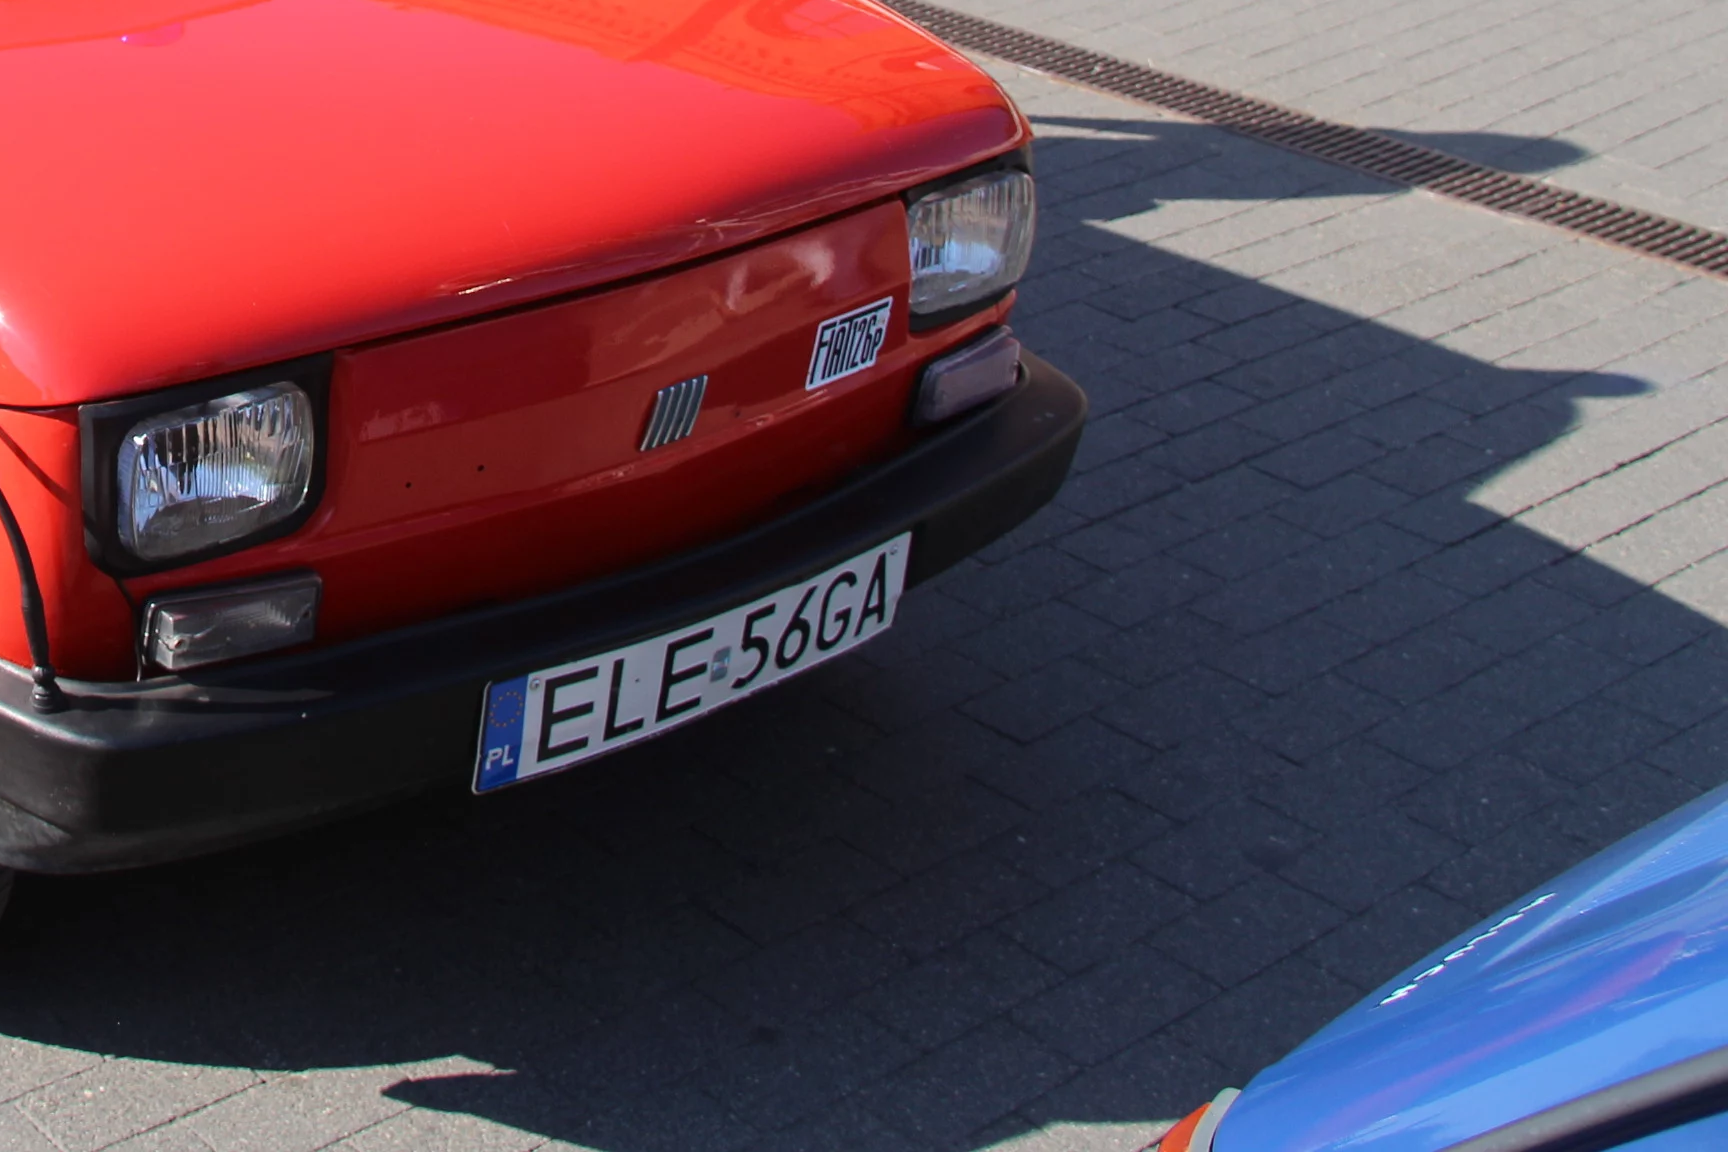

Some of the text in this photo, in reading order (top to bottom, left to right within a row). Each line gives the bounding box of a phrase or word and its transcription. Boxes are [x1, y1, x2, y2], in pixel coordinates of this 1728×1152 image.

[535, 550, 890, 763] ELE 56GA
[484, 744, 516, 772] PL
